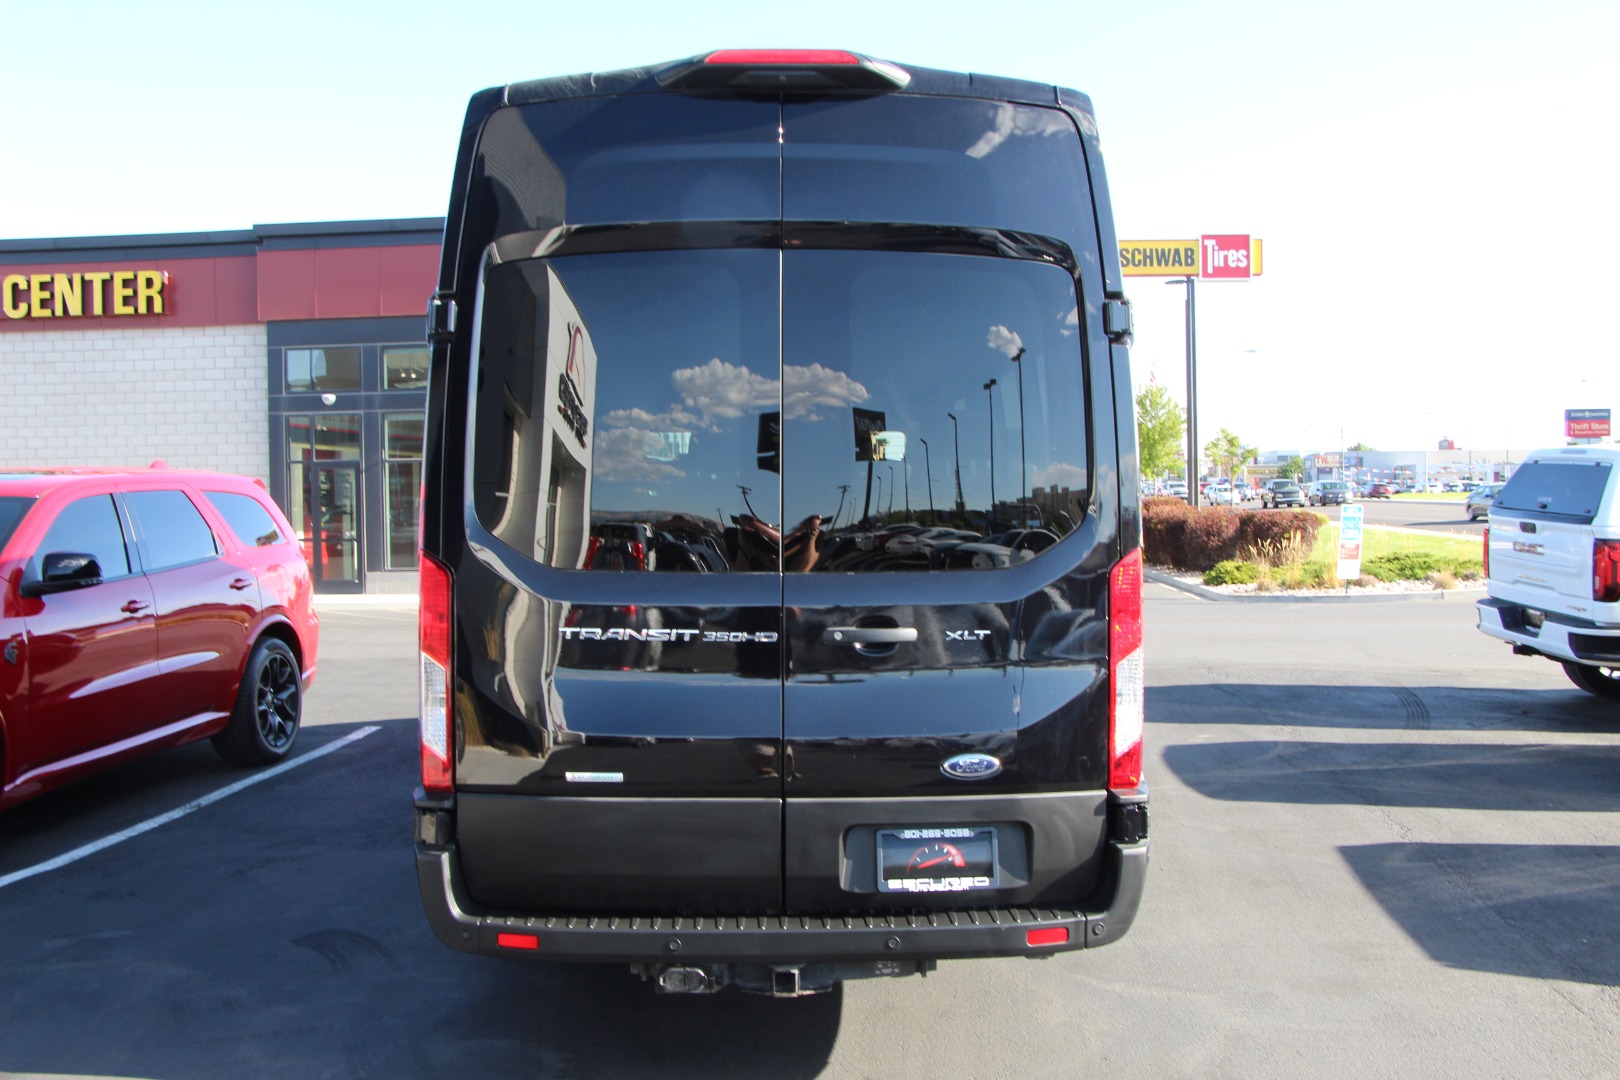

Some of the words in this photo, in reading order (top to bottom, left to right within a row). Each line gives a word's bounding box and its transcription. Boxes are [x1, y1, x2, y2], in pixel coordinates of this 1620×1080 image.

[1119, 248, 1195, 267] SCHWAB
[1203, 239, 1248, 274] Tires
[3, 270, 163, 319] CENTER
[1570, 422, 1589, 430] Thrift
[1591, 422, 1608, 430] Store
[558, 627, 700, 642] TRANSIT
[702, 631, 778, 642] 350HD
[945, 629, 991, 641] XLT
